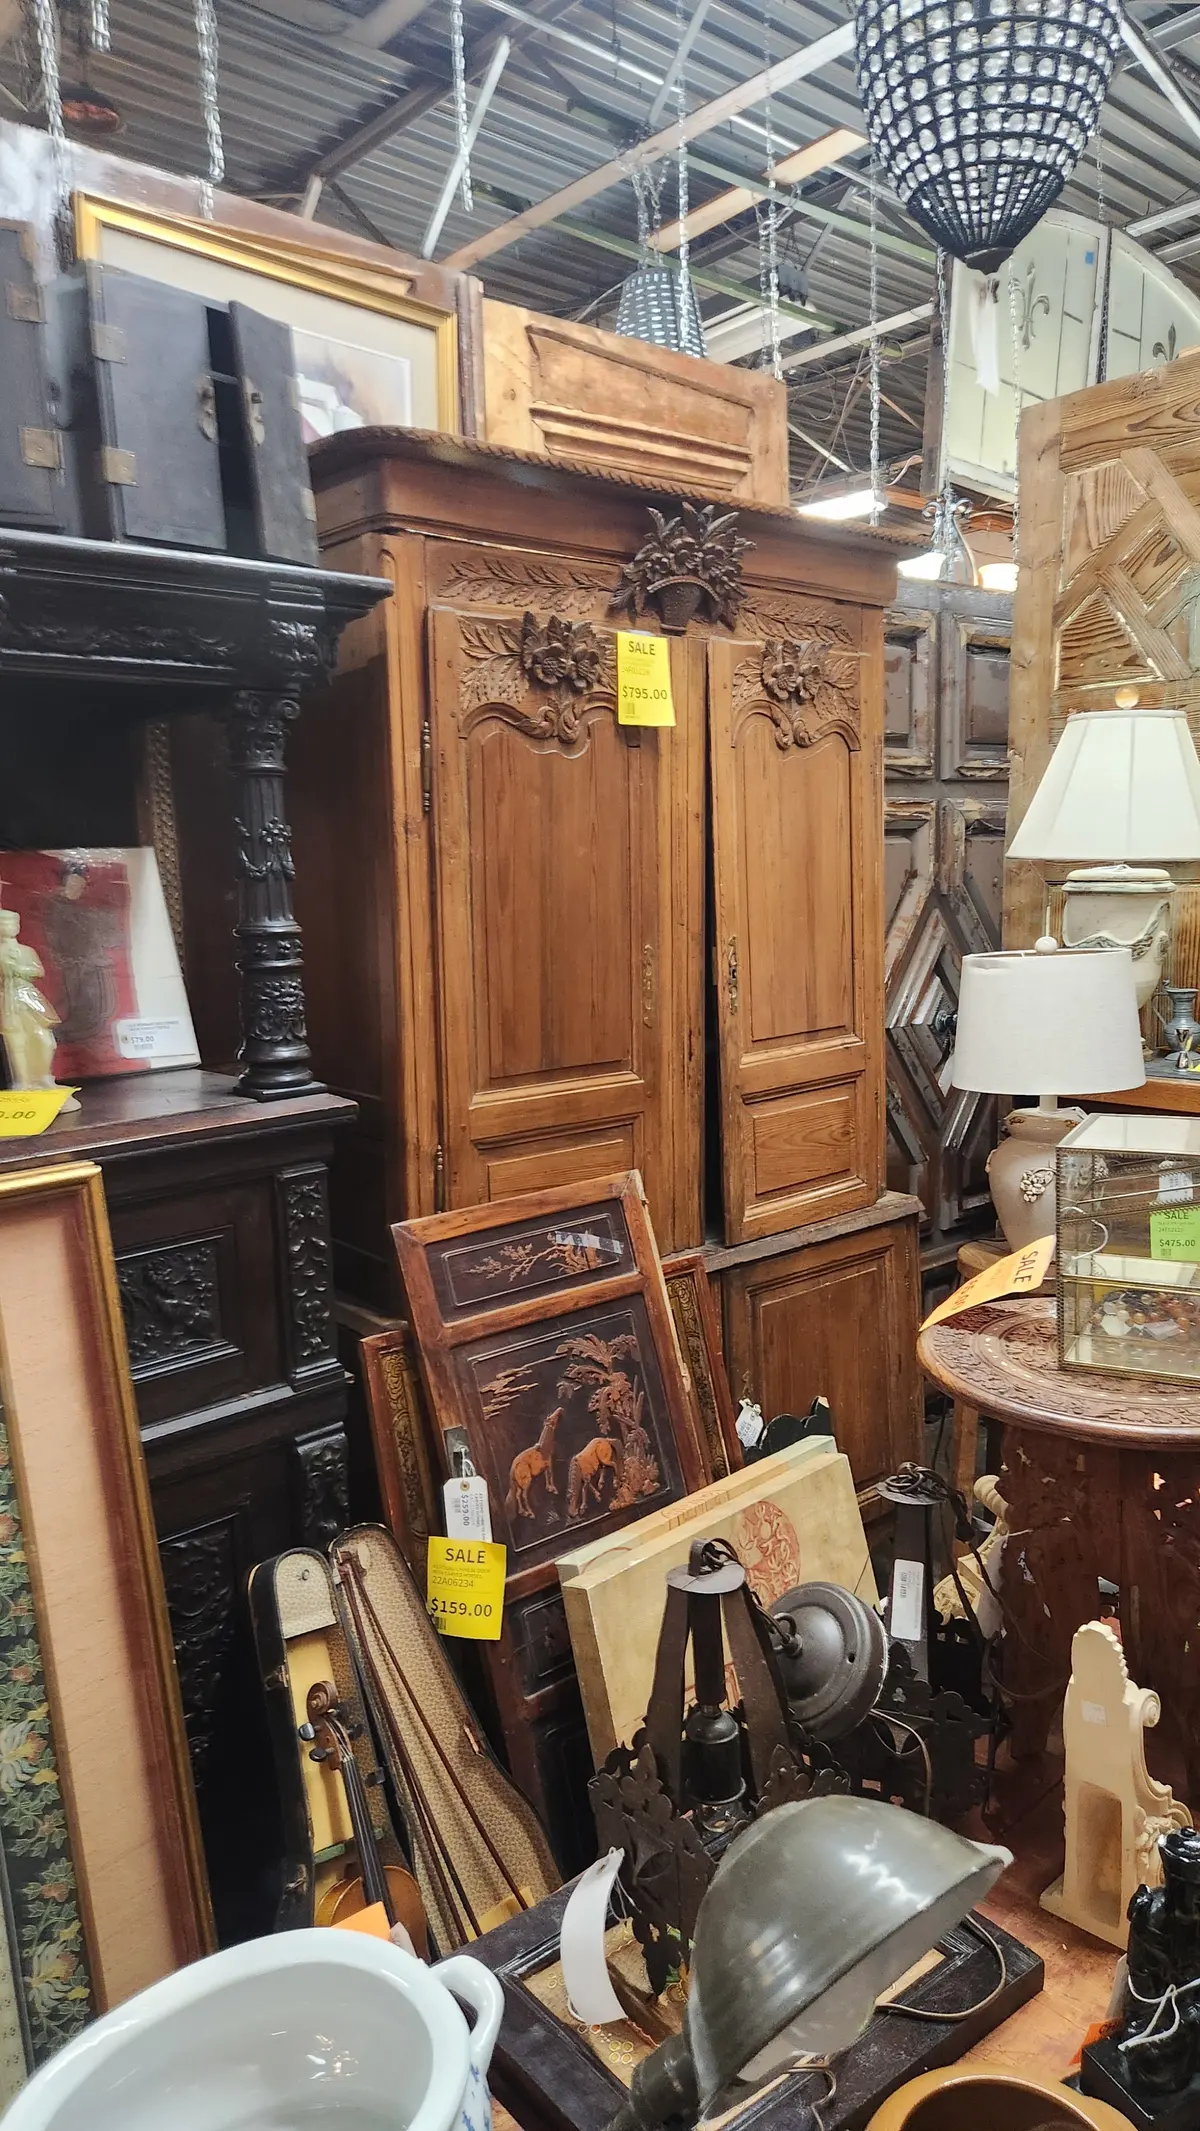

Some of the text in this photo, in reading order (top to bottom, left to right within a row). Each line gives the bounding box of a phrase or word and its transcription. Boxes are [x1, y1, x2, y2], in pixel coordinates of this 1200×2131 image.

[628, 640, 656, 656] SALE
[622, 685, 668, 700] $795.00
[1164, 1209, 1190, 1220] SALE
[1159, 1239, 1196, 1247] $475.00
[1013, 1250, 1039, 1285] SALE
[461, 1494, 470, 1527] $259.00
[445, 1547, 486, 1564] SALE
[431, 1575, 474, 1588] 22A06234
[430, 1597, 492, 1617] $159.00
